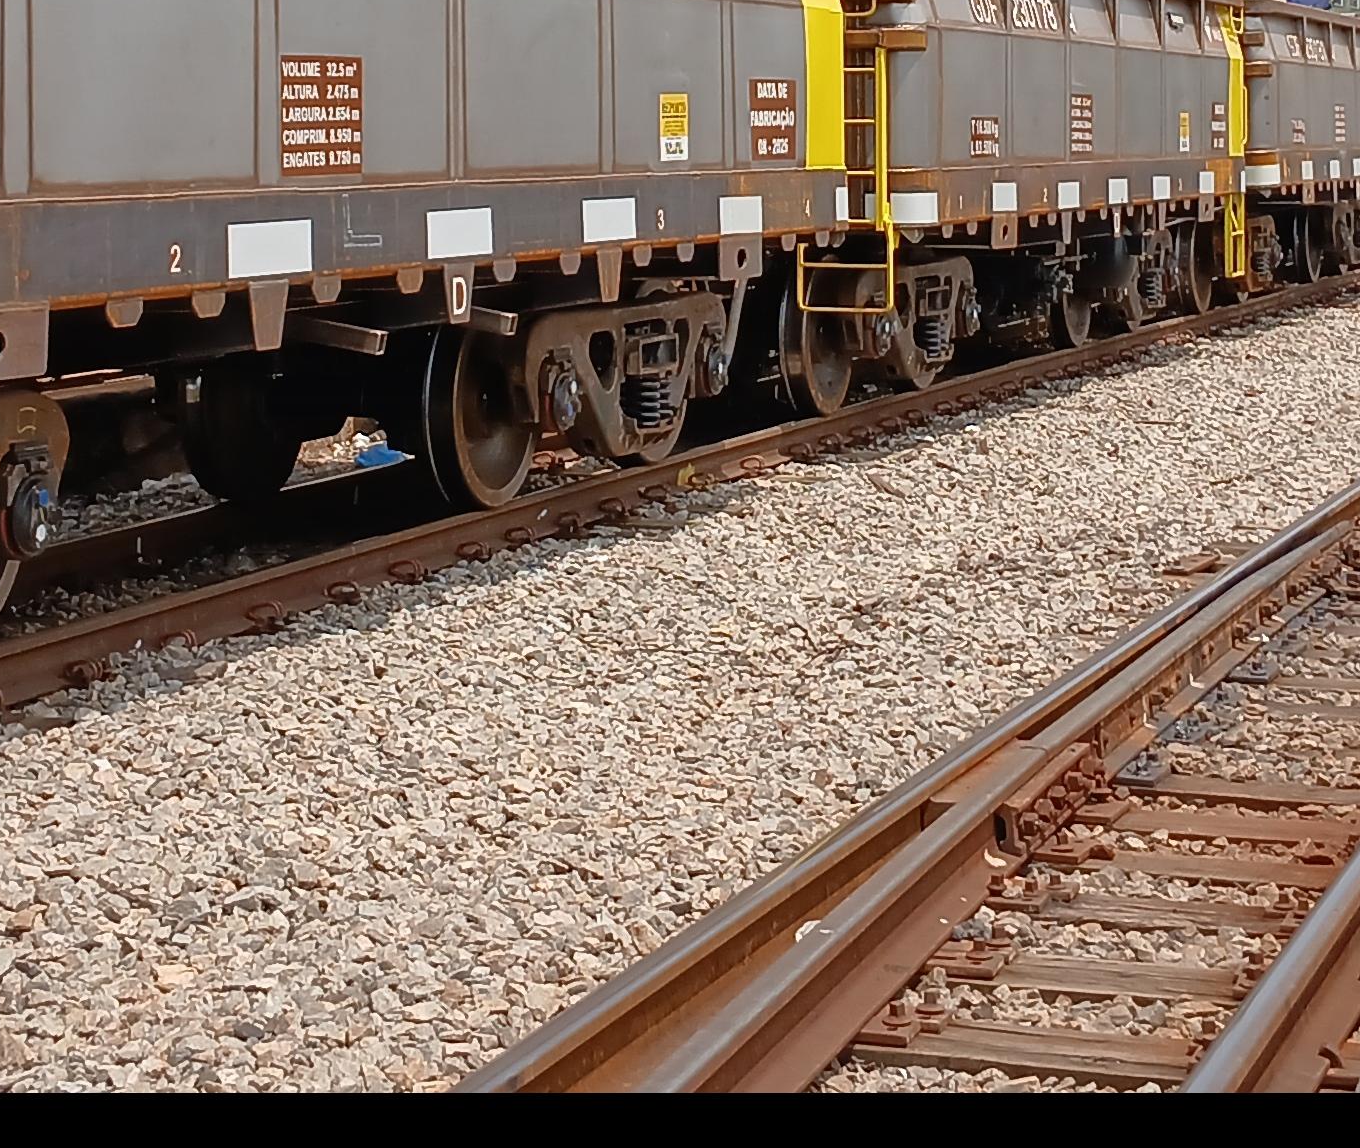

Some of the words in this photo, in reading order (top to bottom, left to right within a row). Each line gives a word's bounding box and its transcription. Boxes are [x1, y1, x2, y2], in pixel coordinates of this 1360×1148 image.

[281, 62, 321, 77] VOLUME
[282, 84, 319, 100] ALTURA
[350, 87, 359, 99] m
[756, 82, 777, 99] DATA
[777, 82, 788, 99] DE
[282, 106, 327, 122] LARGURA
[351, 109, 360, 121] m
[750, 106, 795, 130] FABRICAÇÃO
[282, 128, 328, 146] COMPRIM.
[353, 131, 361, 143] m
[283, 151, 326, 168] ENGATES
[352, 153, 361, 164] m
[804, 198, 811, 218] 4
[657, 208, 665, 230] 3
[170, 244, 181, 273] 2
[452, 276, 467, 316] D
